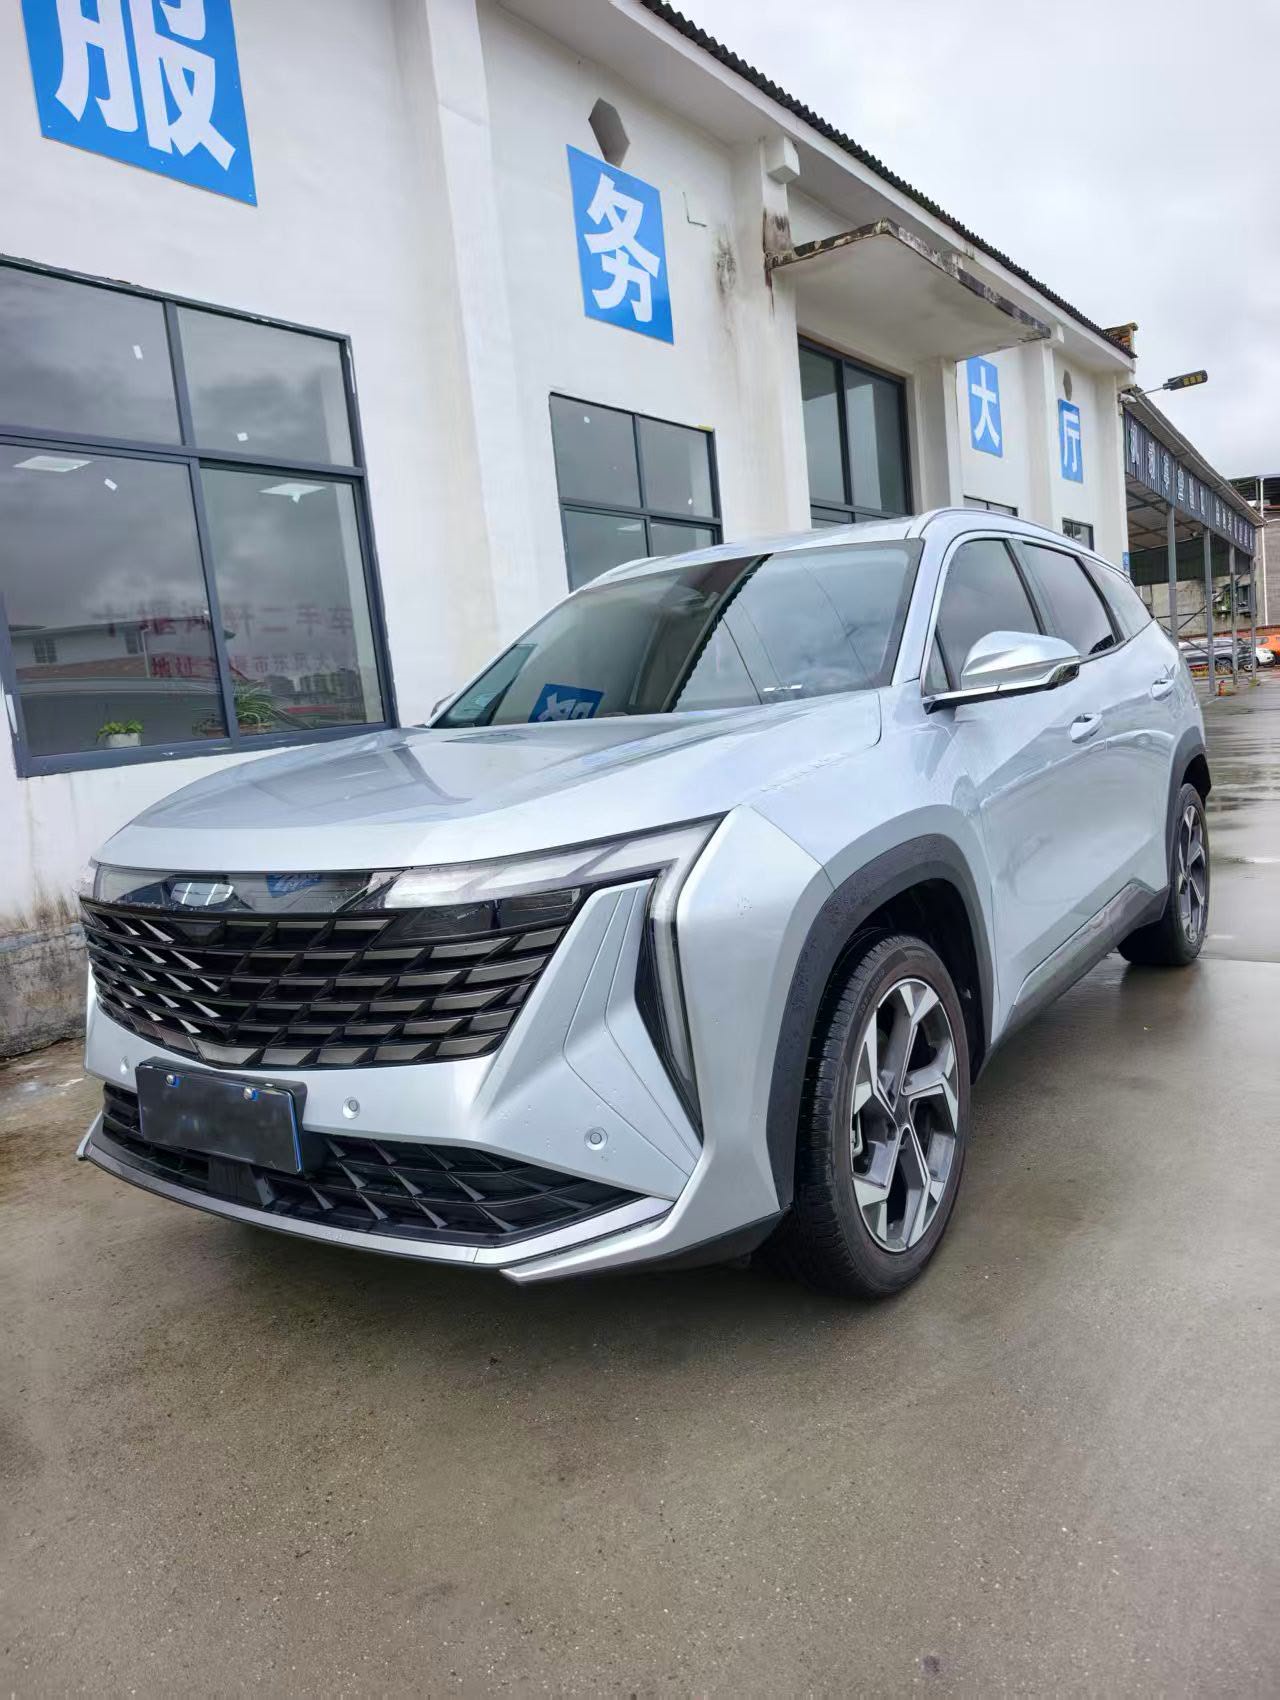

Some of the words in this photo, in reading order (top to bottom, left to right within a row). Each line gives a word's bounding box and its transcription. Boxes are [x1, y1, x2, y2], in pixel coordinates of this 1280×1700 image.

[54, 0, 236, 171] 服
[584, 172, 660, 323] 务
[971, 366, 1001, 448] 大
[1062, 409, 1080, 473] 厅
